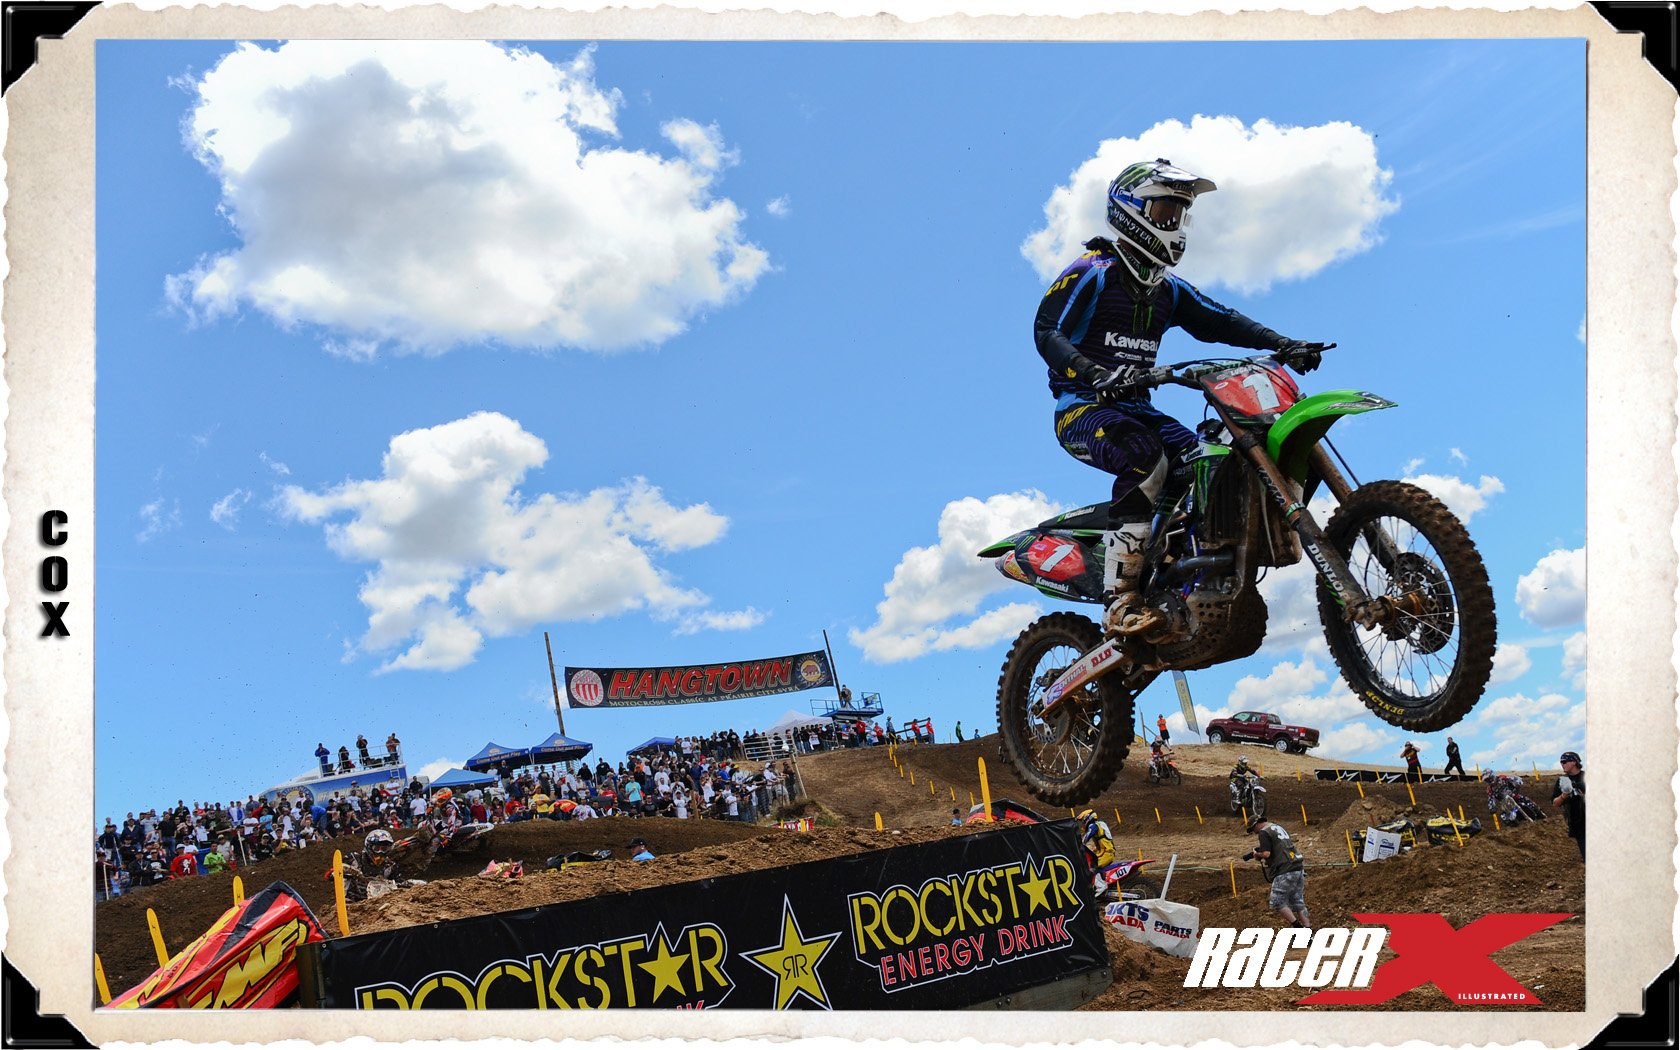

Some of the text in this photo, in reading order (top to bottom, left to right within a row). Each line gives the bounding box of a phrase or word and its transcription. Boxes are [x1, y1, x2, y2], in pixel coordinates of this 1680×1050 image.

[1113, 207, 1153, 245] MONSTER
[1242, 372, 1281, 411] 1
[1064, 506, 1096, 519] Kawasaki
[1039, 543, 1075, 573] 1
[1035, 576, 1070, 593] Kawasaki
[608, 657, 794, 700] HANGTOWN
[608, 699, 666, 707] MOTOCROSS
[1115, 867, 1128, 878] 101
[851, 858, 1079, 955] ROCKSTAR
[1154, 920, 1193, 935] PARTS
[880, 914, 1070, 986] ENERGY DRINK
